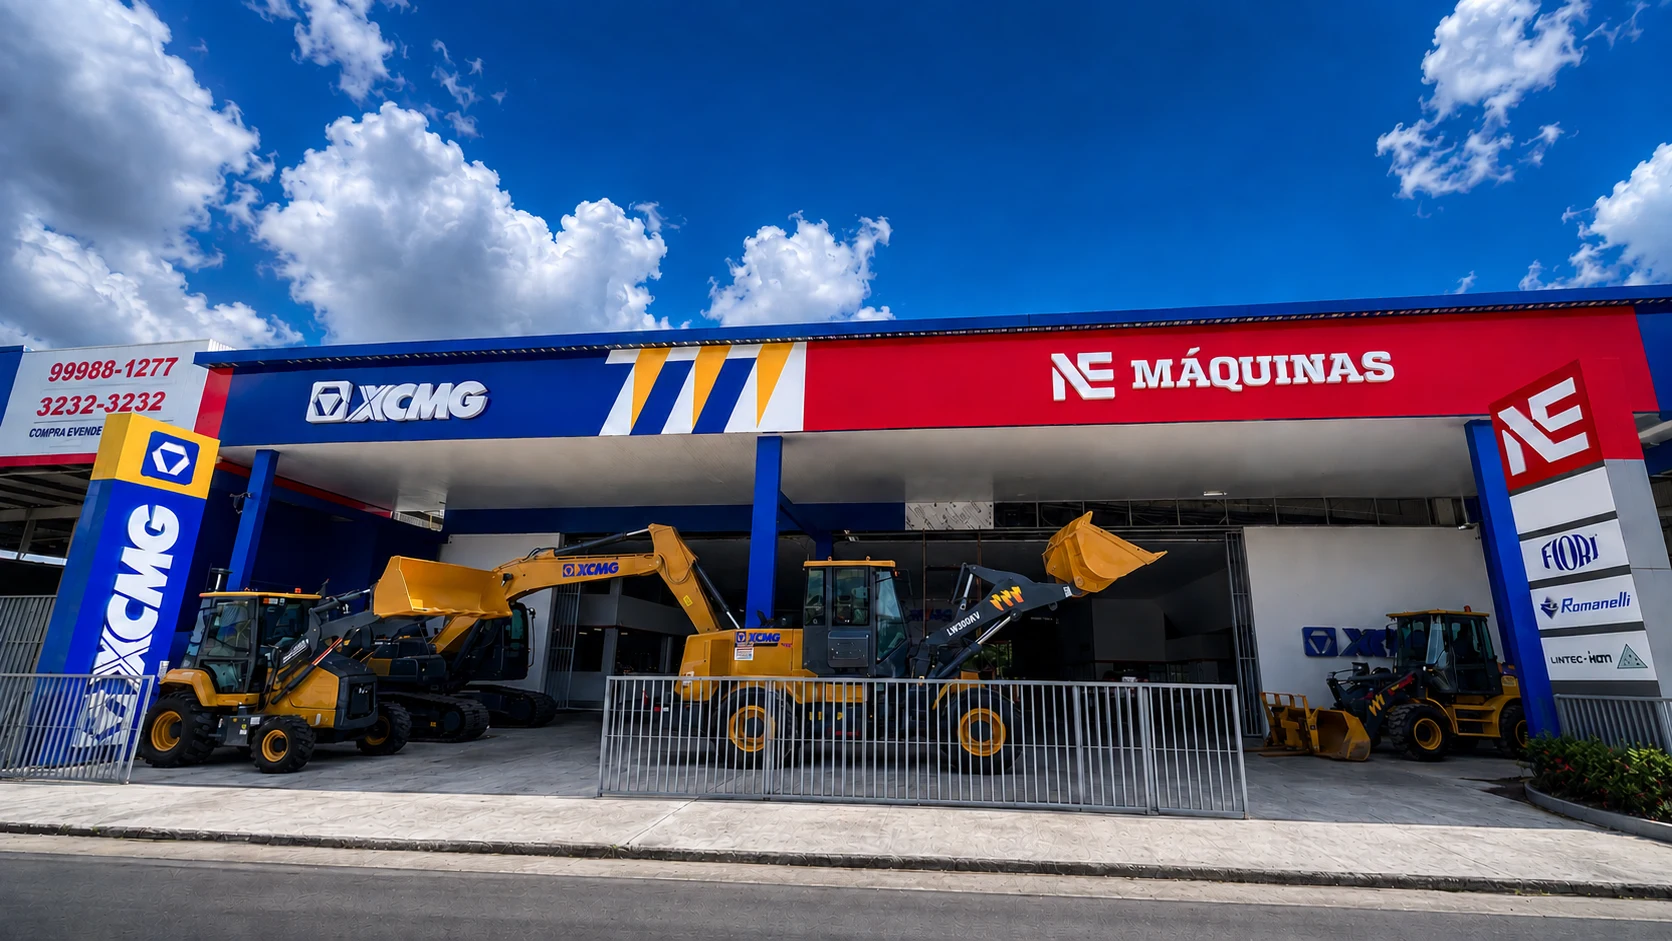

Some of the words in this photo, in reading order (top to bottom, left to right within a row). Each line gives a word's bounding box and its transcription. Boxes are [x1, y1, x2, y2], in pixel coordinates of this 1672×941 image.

[48, 357, 179, 382] 99988-1277
[1131, 347, 1395, 392] MÁQUINAS
[36, 391, 166, 416] 3232-3232
[346, 380, 489, 422] XCMG
[29, 427, 66, 438] COMPRA
[1541, 534, 1599, 571] FIORI
[577, 562, 619, 576] XCMG
[91, 504, 180, 690] XCMG
[1561, 591, 1631, 613] Romanelli
[748, 632, 781, 643] XCMG
